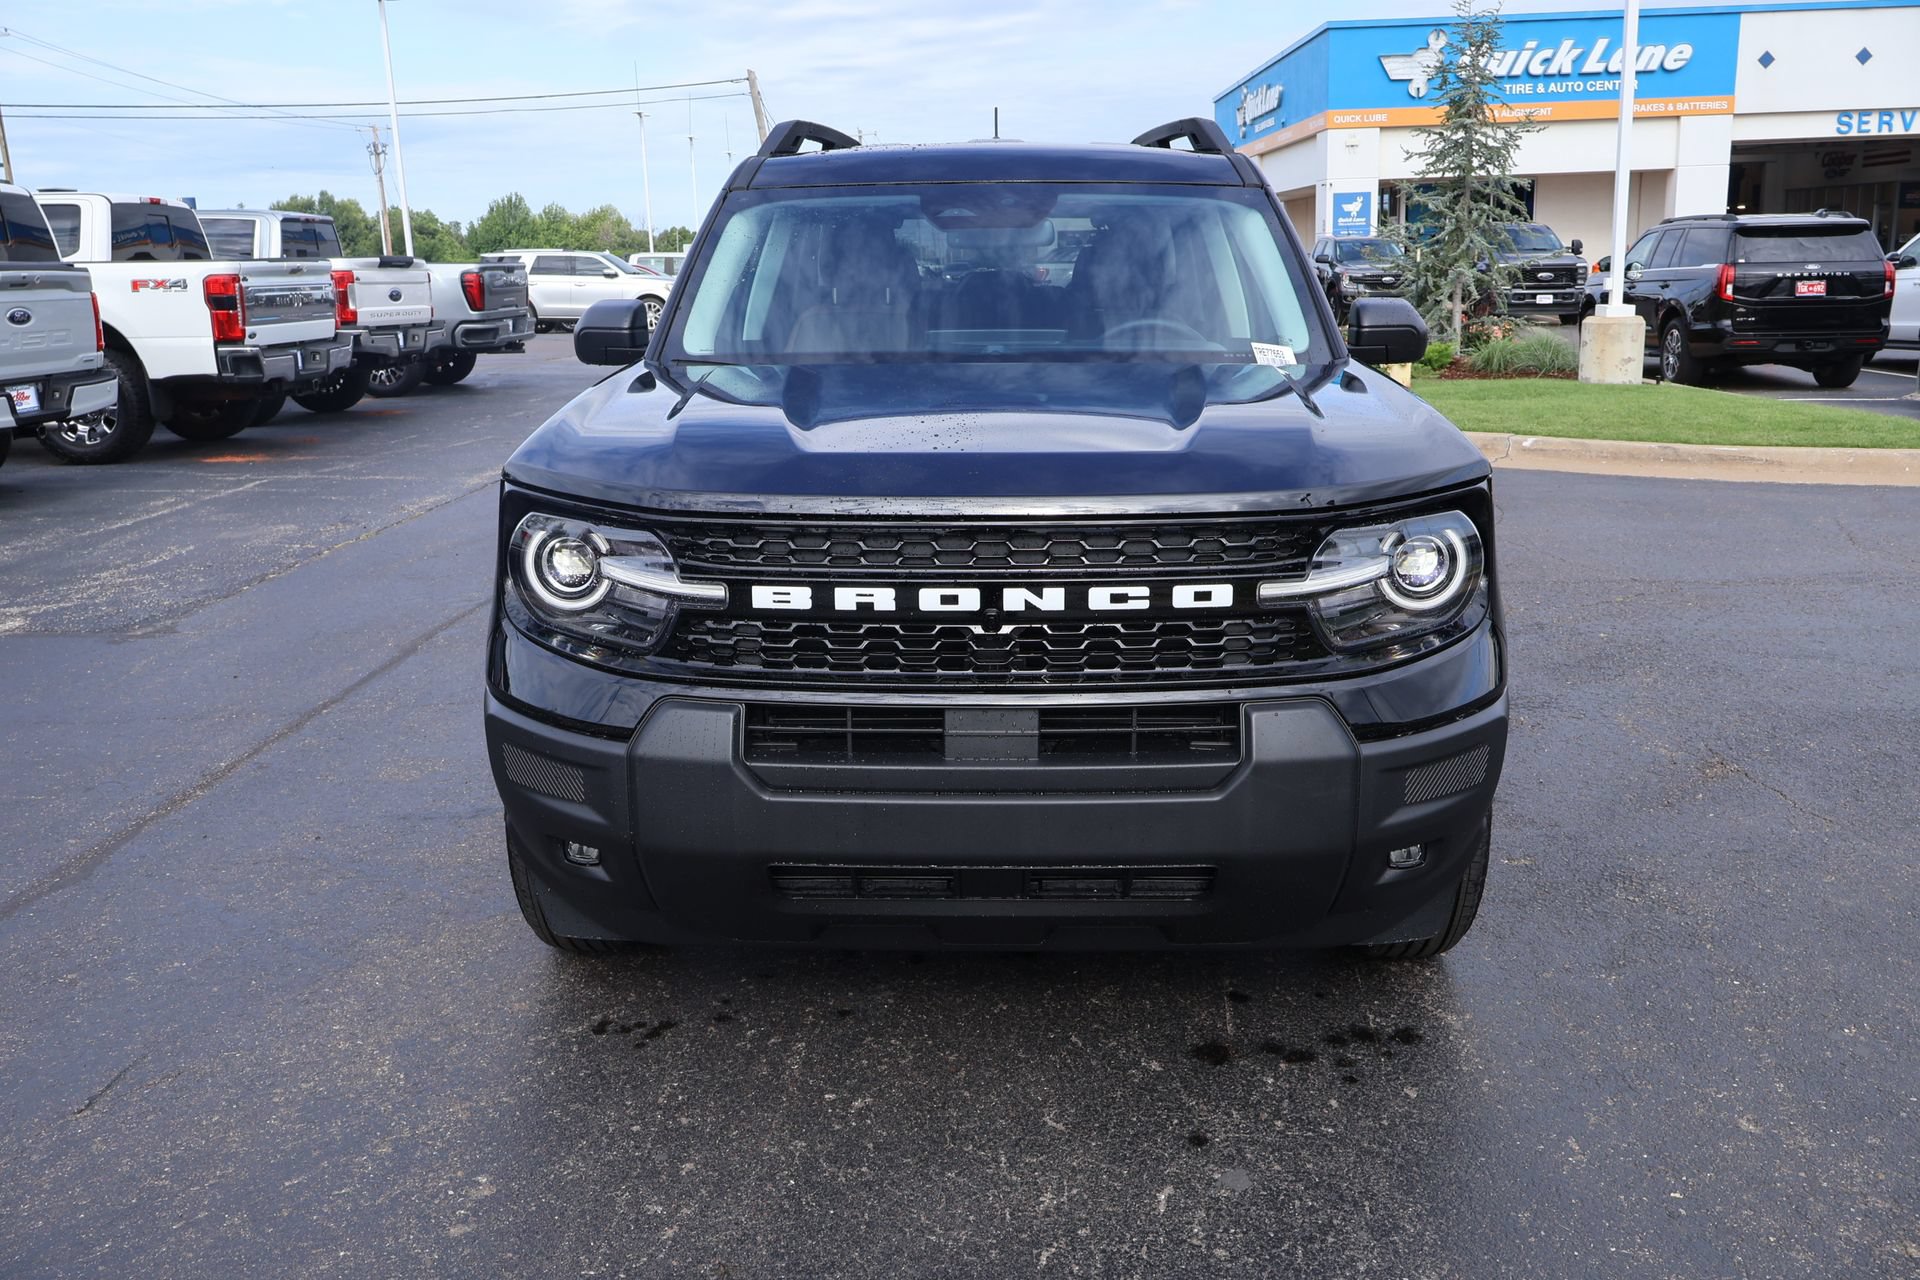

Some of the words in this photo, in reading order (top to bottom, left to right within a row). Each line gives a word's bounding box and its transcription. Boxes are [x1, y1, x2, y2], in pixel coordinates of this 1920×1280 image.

[1580, 38, 1694, 73] Lane
[1503, 83, 1534, 95] TIRE
[1536, 82, 1545, 93] &
[1548, 81, 1584, 93] AUTO
[1586, 79, 1638, 91] CENT
[1633, 103, 1665, 112] RAKES
[1667, 103, 1674, 111] &
[1676, 101, 1728, 110] BATTERIES
[1333, 114, 1361, 124] QUICK
[1363, 113, 1388, 122] LUBE
[1835, 110, 1918, 135] SERV
[131, 278, 188, 292] FX4
[369, 311, 400, 319] SUPER
[751, 584, 1234, 612] BRONCO
